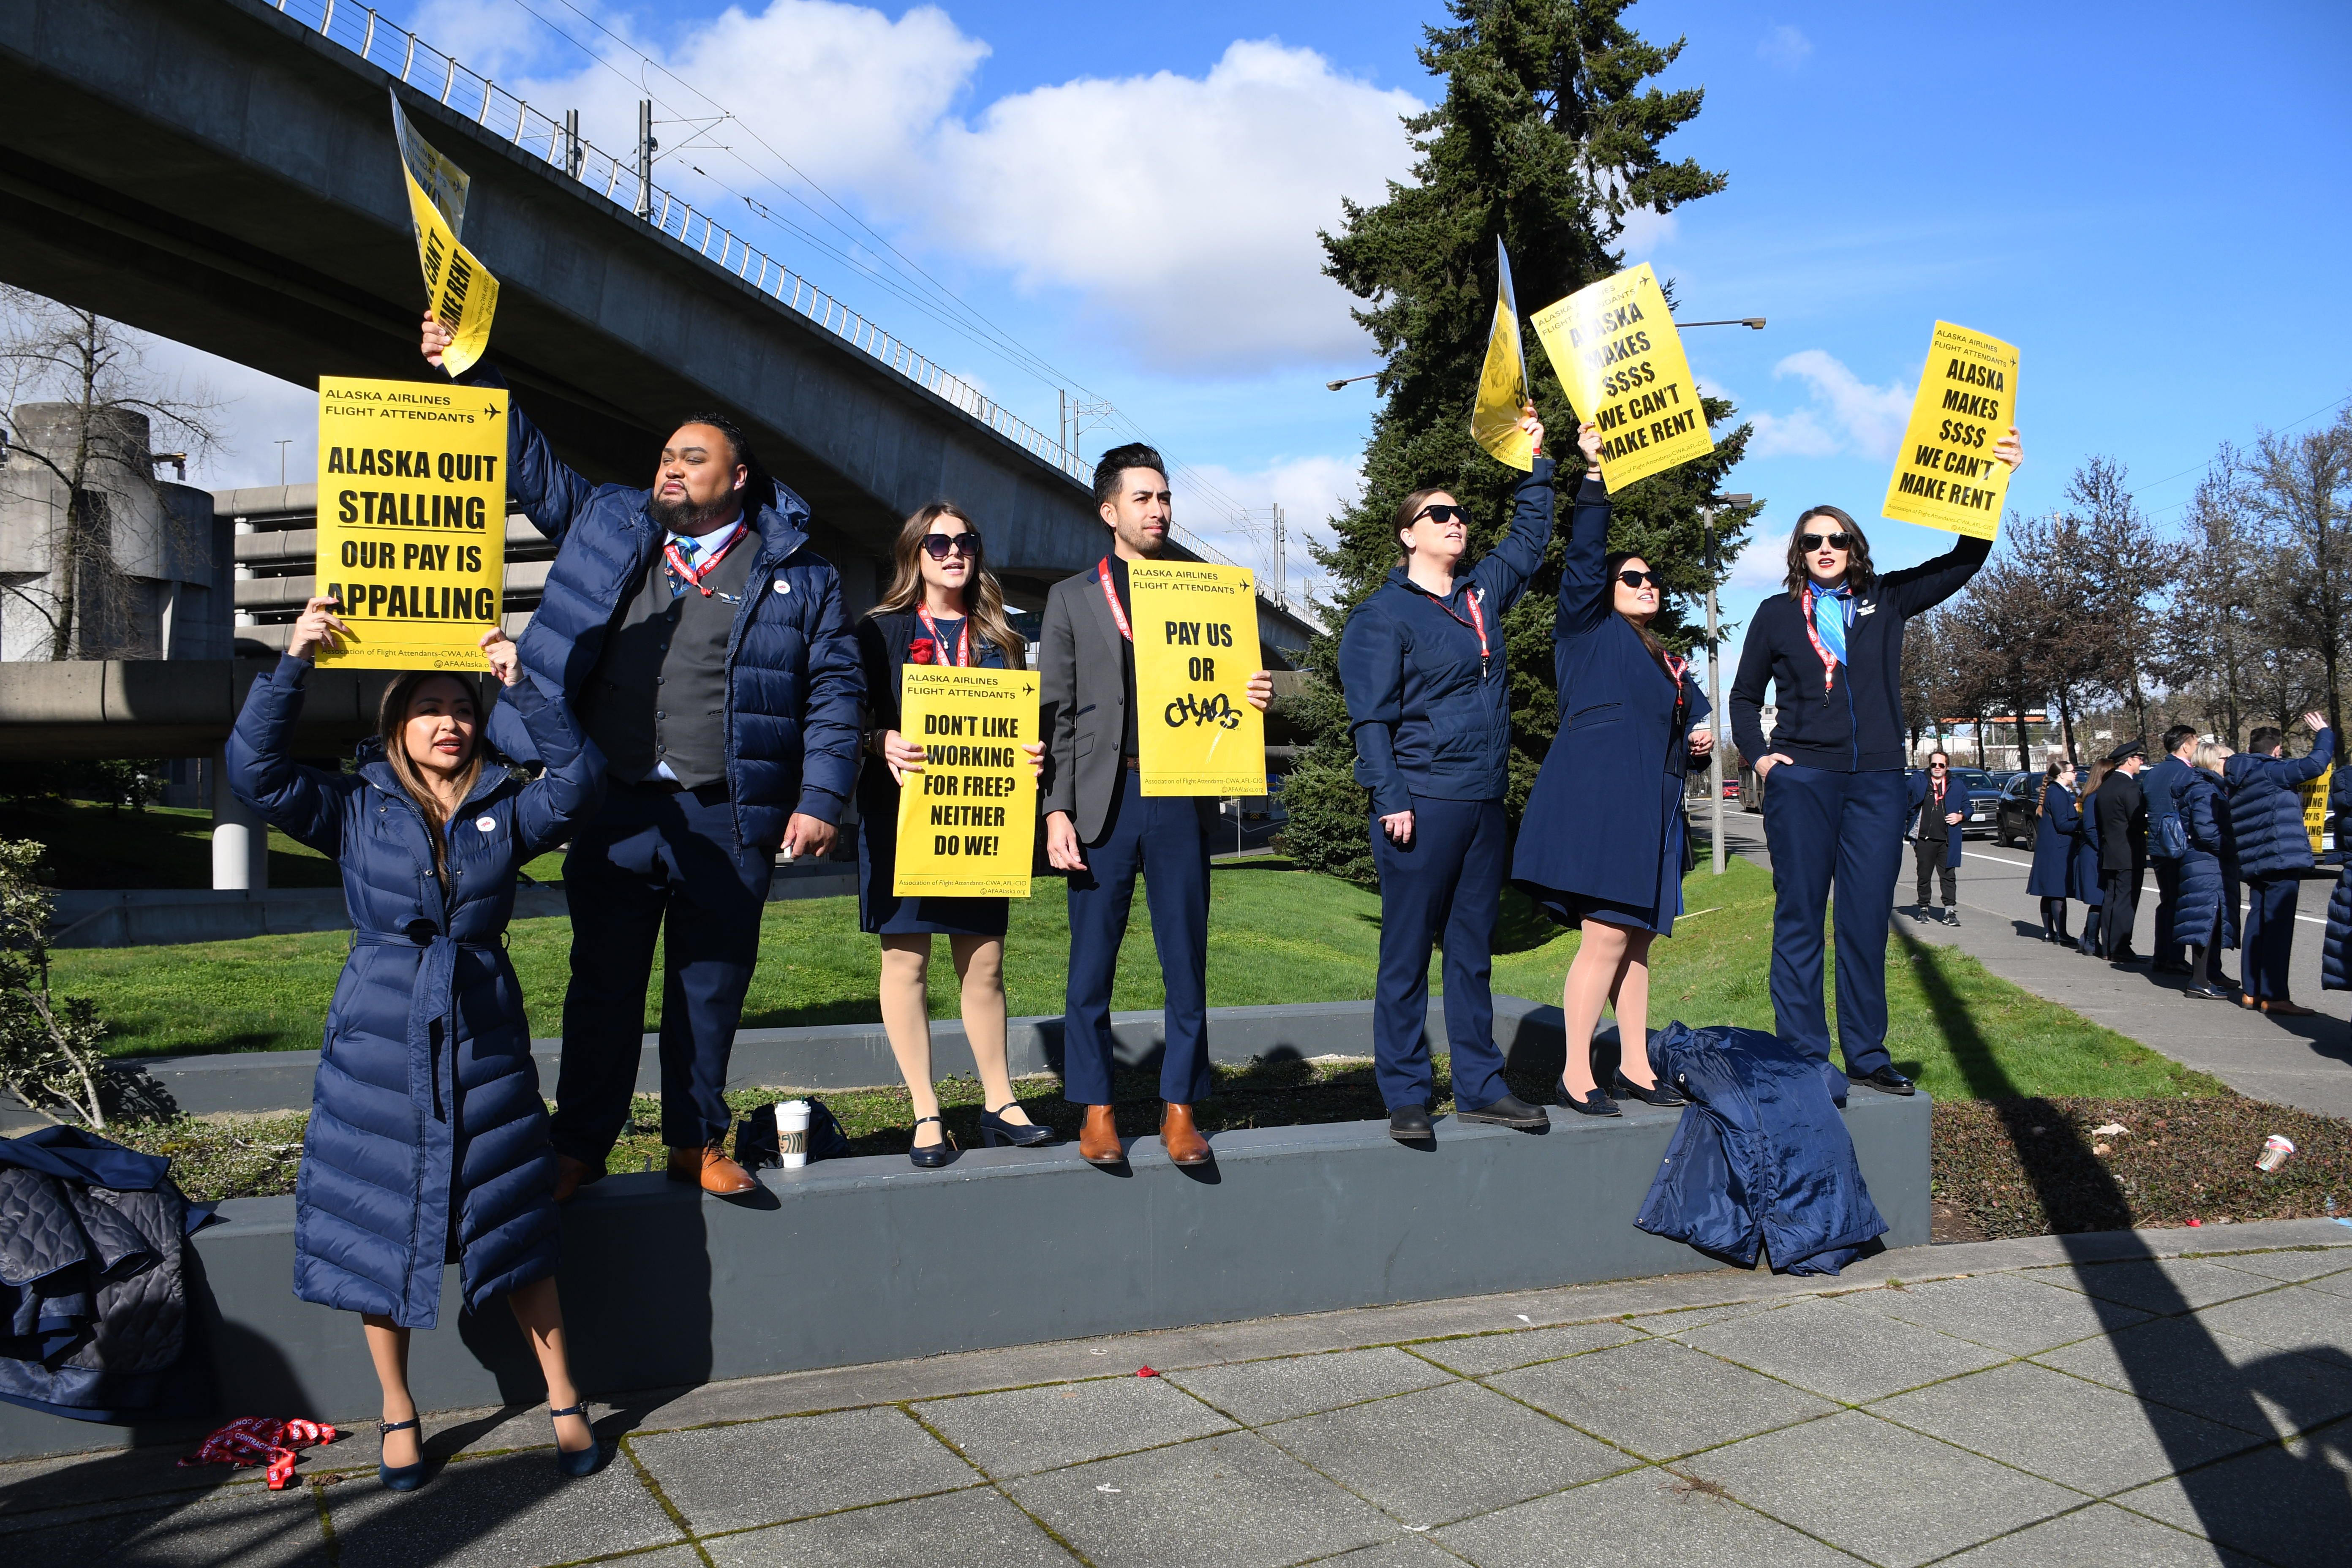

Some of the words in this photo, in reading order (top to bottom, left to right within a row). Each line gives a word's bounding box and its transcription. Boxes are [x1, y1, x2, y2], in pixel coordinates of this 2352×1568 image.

[446, 248, 472, 302] RENT
[1538, 305, 1572, 327] ALASKA
[1542, 316, 1572, 336] FLIGHT
[1569, 302, 1644, 349] AASKA
[1585, 331, 1651, 372] MAKES
[1936, 330, 1966, 343] ALASKA
[1968, 339, 1998, 353] AIRLINES
[1934, 341, 1961, 353] FLIGHT
[1963, 348, 2006, 368] ATTENDANTS
[1602, 361, 1655, 398] $$$$
[1946, 359, 2004, 393] ALASKA
[325, 389, 383, 401] ALASKA
[387, 393, 451, 406] AIRLINES
[1596, 404, 1627, 433] WE
[1628, 383, 1680, 420] CAN'T
[1942, 389, 1999, 421] MAKES
[326, 406, 375, 417] FLIGHT
[380, 409, 475, 423] ATTENDANTS
[1603, 429, 1649, 464] MAKE
[1650, 408, 1696, 444] RENT
[1939, 419, 1987, 449] $$$$
[327, 446, 430, 479] ALASKA
[438, 452, 498, 483] QUIT
[1633, 463, 1645, 471] Flight
[1914, 444, 1943, 469] WE
[1944, 452, 1994, 480] CAN'T
[1898, 472, 1947, 501] MAKE
[1948, 483, 1996, 512] RENT
[338, 490, 485, 529] STALLING
[341, 540, 395, 569] OUR
[403, 543, 450, 571] PAY
[457, 545, 482, 573] IS
[1132, 569, 1173, 577] ALASKA
[1176, 571, 1218, 580] AIRLINES
[1103, 580, 1113, 594] NOW
[1133, 582, 1168, 590] FLIGHT
[1172, 583, 1235, 594] ATTENDANTS
[327, 583, 494, 621] APPALLING
[1108, 594, 1123, 622] CONTRACT
[924, 618, 933, 631] NOW
[1165, 621, 1201, 645] PAY
[1206, 623, 1233, 648] US
[907, 674, 950, 683] ALASKA
[953, 677, 998, 686] AIRLINES
[1188, 657, 1214, 682] OR
[907, 687, 945, 696] FLIGHT
[948, 689, 1016, 699] ATTENDANTS
[1165, 693, 1243, 729] CHAOS
[924, 714, 978, 737] DON'T
[982, 717, 1018, 738] LIKE
[926, 745, 1014, 768] WORKING
[924, 775, 958, 795] FOR
[963, 777, 1015, 797] FREE?
[2312, 785, 2327, 794] QUIT
[931, 805, 1005, 827] NEITHER
[2313, 813, 2319, 821] IS
[934, 835, 959, 856] DO
[964, 836, 999, 856] WE!
[235, 1432, 267, 1451] CONTRACT
